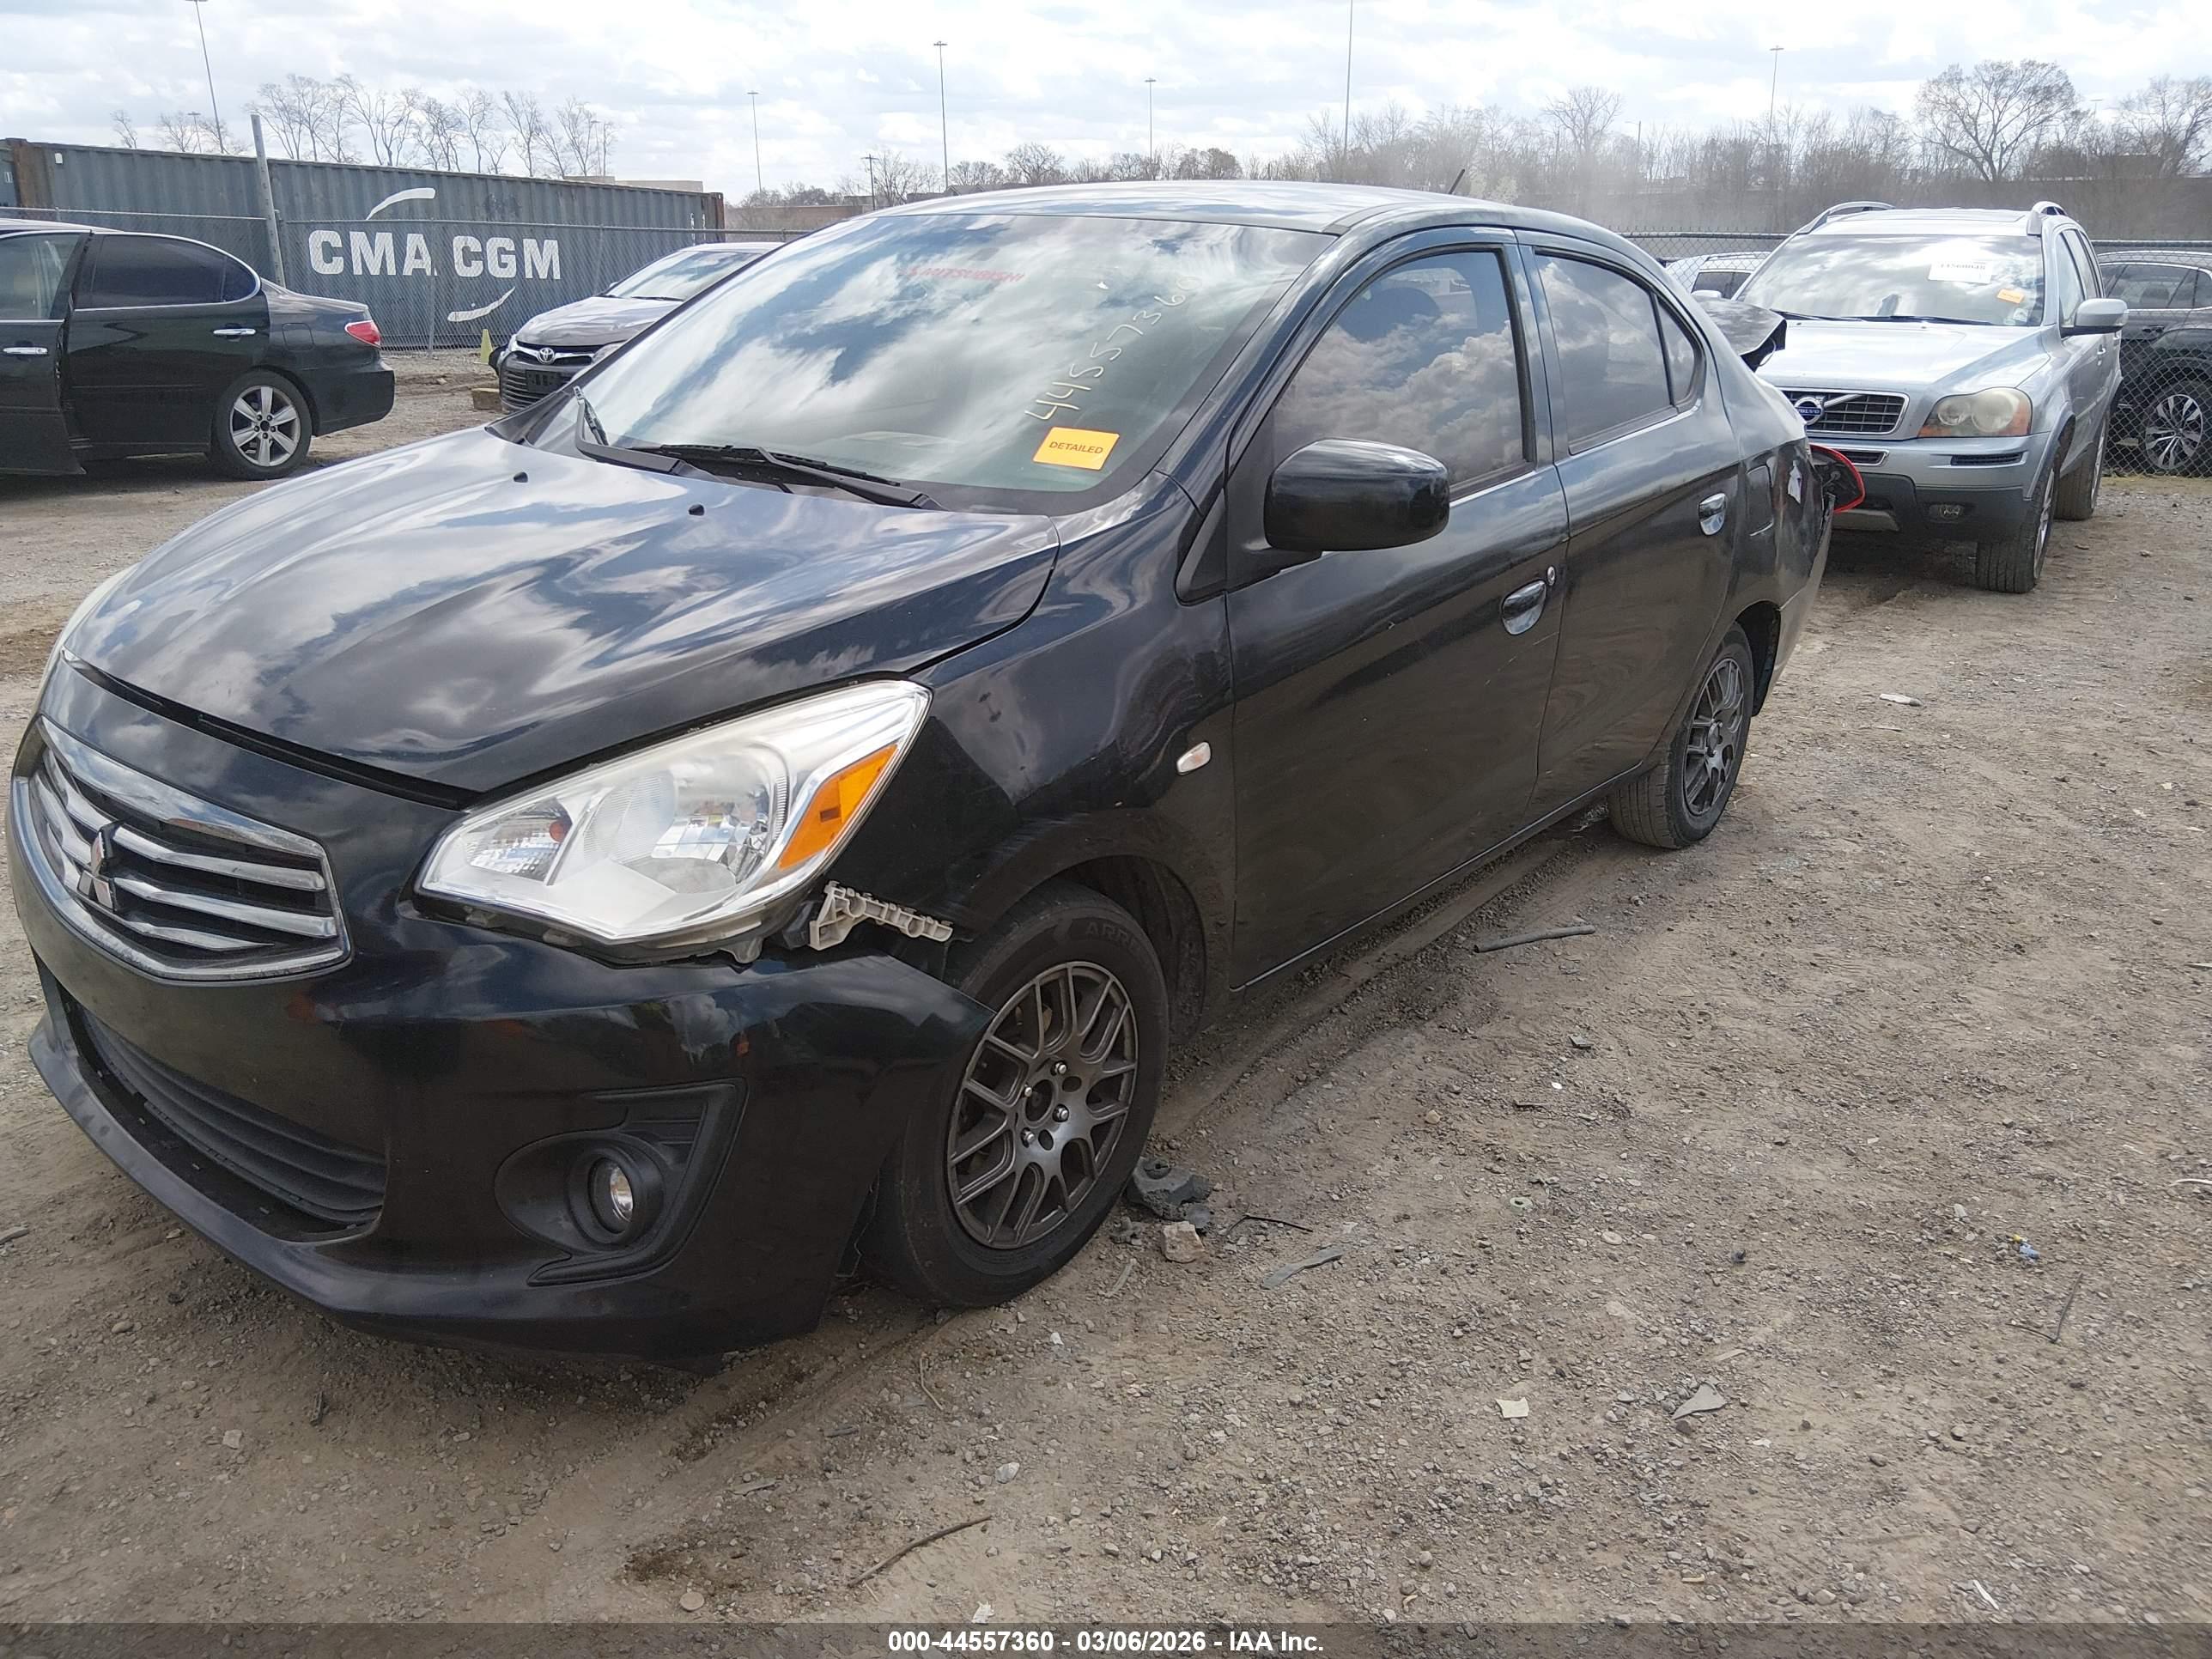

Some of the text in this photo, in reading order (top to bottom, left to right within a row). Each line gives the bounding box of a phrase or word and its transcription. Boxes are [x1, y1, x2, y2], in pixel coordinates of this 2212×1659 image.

[308, 229, 561, 280] CMA CGM
[1048, 441, 1104, 454] DETAILED
